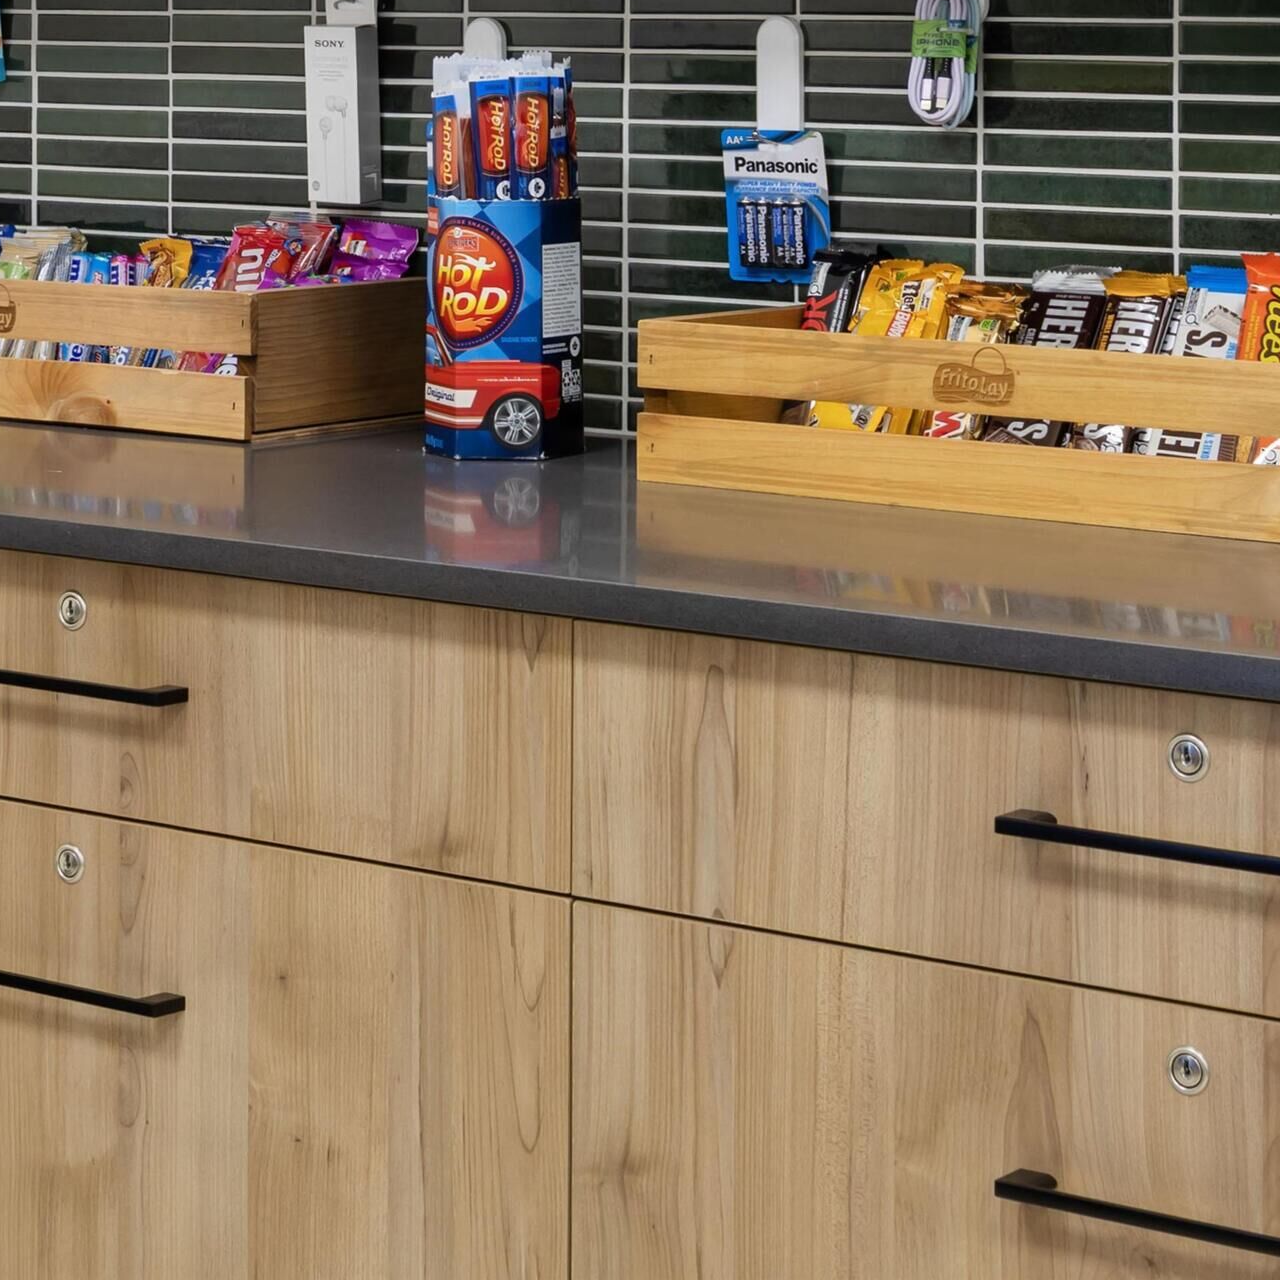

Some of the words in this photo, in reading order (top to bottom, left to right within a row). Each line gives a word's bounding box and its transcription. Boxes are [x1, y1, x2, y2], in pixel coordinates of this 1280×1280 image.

[314, 39, 344, 48] SONY
[734, 156, 818, 174] Panasonic
[757, 206, 769, 264] Panasonic
[793, 207, 806, 265] Panasonic
[426, 386, 455, 402] Original
